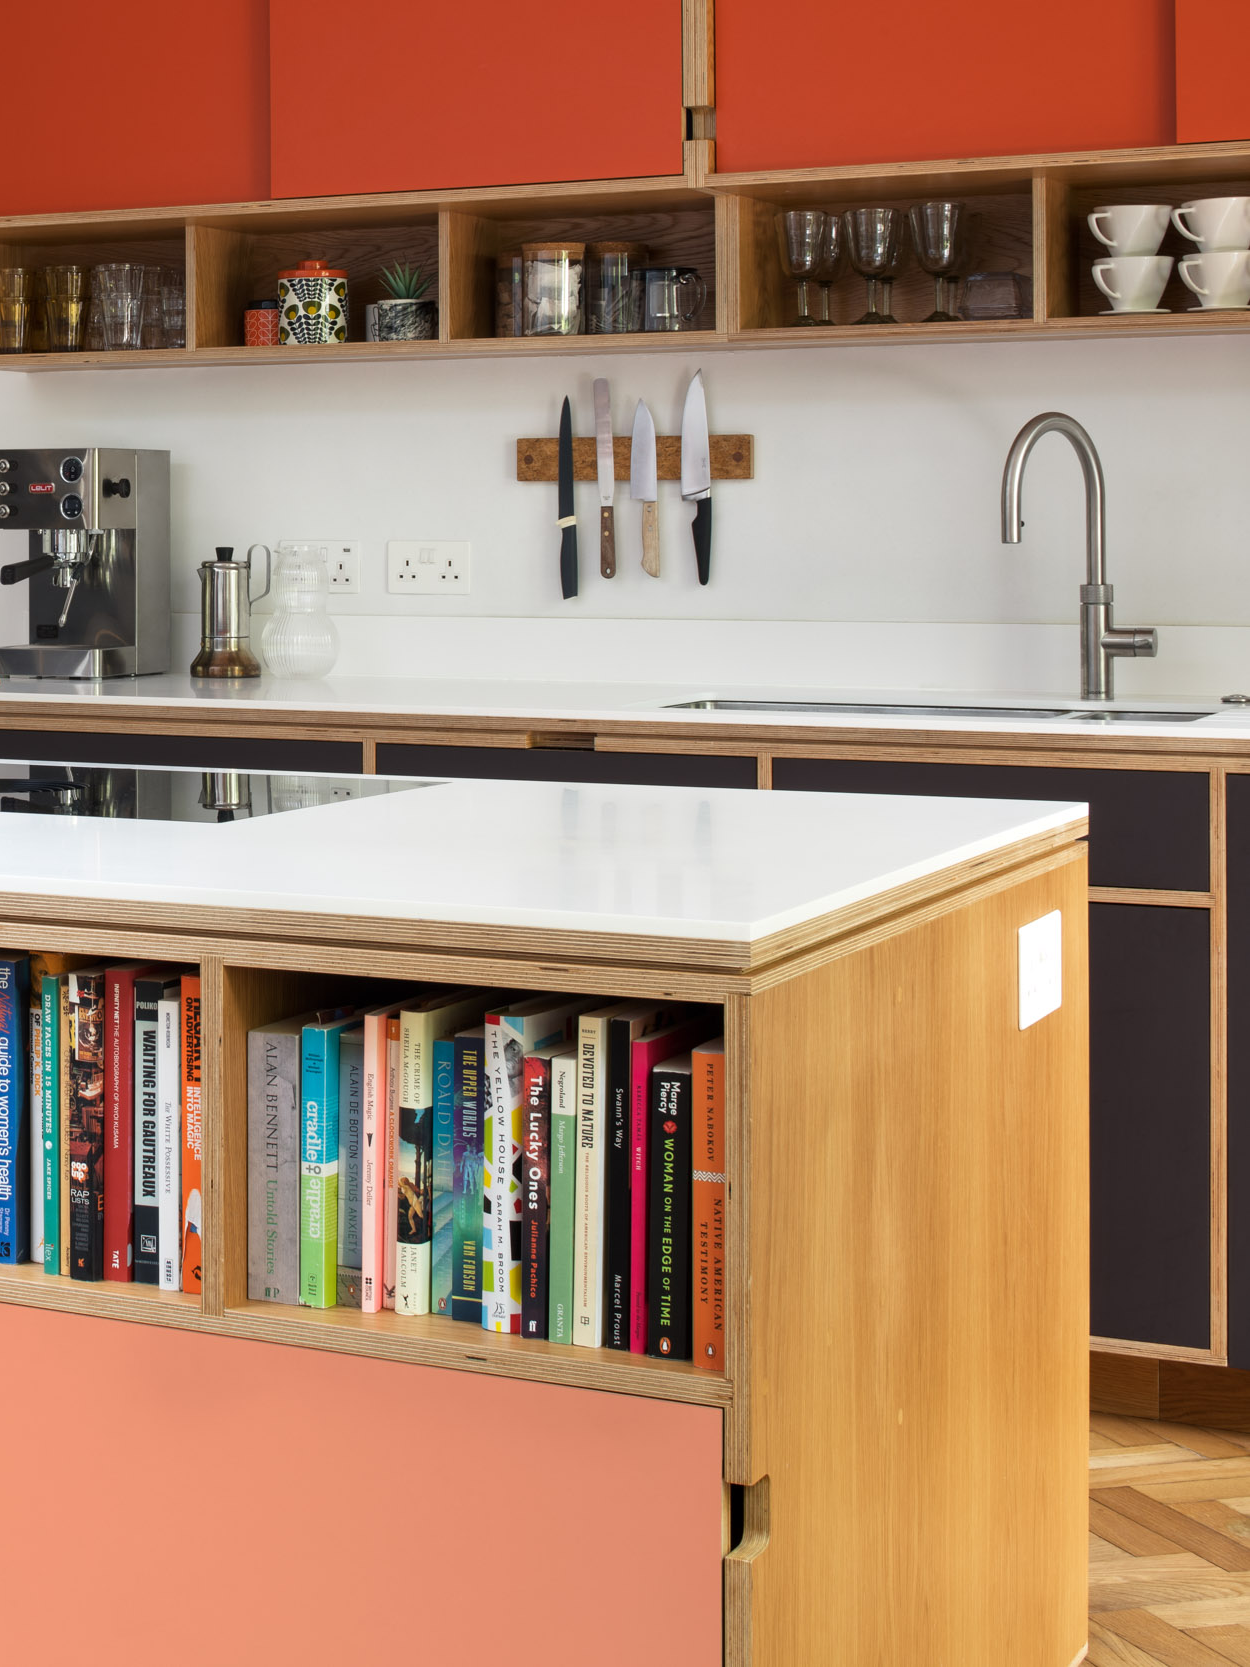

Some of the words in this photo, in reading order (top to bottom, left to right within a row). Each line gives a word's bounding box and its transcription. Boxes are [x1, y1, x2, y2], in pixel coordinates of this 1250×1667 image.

[186, 997, 193, 1012] ON
[142, 1030, 156, 1089] WAITING
[186, 1015, 194, 1082] ADVERTISING
[463, 1050, 477, 1065] THE
[490, 1031, 499, 1059] THE
[45, 1060, 51, 1071] IN
[266, 1042, 278, 1087] ALAN
[350, 1065, 359, 1097] ALAIN
[582, 1043, 594, 1088] DEVOTED
[45, 1076, 52, 1087] 15
[366, 1073, 375, 1098] English
[414, 1092, 420, 1104] OF
[437, 1060, 451, 1124] ROALD
[463, 1069, 477, 1097] UPPER
[495, 1067, 505, 1126] YELLOW
[530, 1076, 542, 1106] The
[557, 1071, 566, 1108] Negroland
[658, 1082, 670, 1113] Piercy
[706, 1063, 714, 1101] PETER
[143, 1092, 156, 1116] FOR
[186, 1086, 194, 1111] INTO
[350, 1100, 359, 1115] DE
[367, 1100, 375, 1120] Magic
[582, 1093, 594, 1105] TO
[669, 1082, 680, 1115] Marge
[266, 1094, 278, 1172] BENNETT
[306, 1101, 322, 1160] cradle
[463, 1101, 477, 1138] WORLDS
[557, 1120, 566, 1143] Margo
[581, 1109, 594, 1149] NATURE
[706, 1107, 715, 1162] NABOKOV
[350, 1118, 359, 1159] BOTTON
[526, 1112, 542, 1161] Lucky
[614, 1129, 623, 1148] Way
[142, 1120, 156, 1197] GAUTREAUX
[365, 1160, 374, 1184] Jeremy
[497, 1134, 505, 1184] HOUSE
[557, 1144, 566, 1174] Jefferson
[663, 1138, 674, 1192] WOMAN
[71, 1188, 90, 1198] RAP
[350, 1164, 358, 1201] STATUS
[366, 1186, 374, 1206] Deller
[529, 1167, 541, 1209] Ones
[266, 1180, 278, 1225] Untold
[664, 1197, 672, 1212] ON
[350, 1208, 358, 1254] ANXIETY
[530, 1220, 538, 1259] Julianne
[663, 1216, 671, 1233] THE
[713, 1198, 722, 1249] NATIVE
[45, 1244, 55, 1262] ilex
[266, 1230, 278, 1274] Stories
[661, 1237, 672, 1273] EDGE
[700, 1221, 708, 1304] TESTIMONY
[463, 1259, 476, 1291] FORSON
[530, 1262, 538, 1298] Pachico
[614, 1274, 622, 1308] Marcel
[662, 1277, 670, 1290] OF
[660, 1295, 671, 1326] TIME
[713, 1257, 722, 1331] AMERICAN
[614, 1313, 622, 1345] Proust
